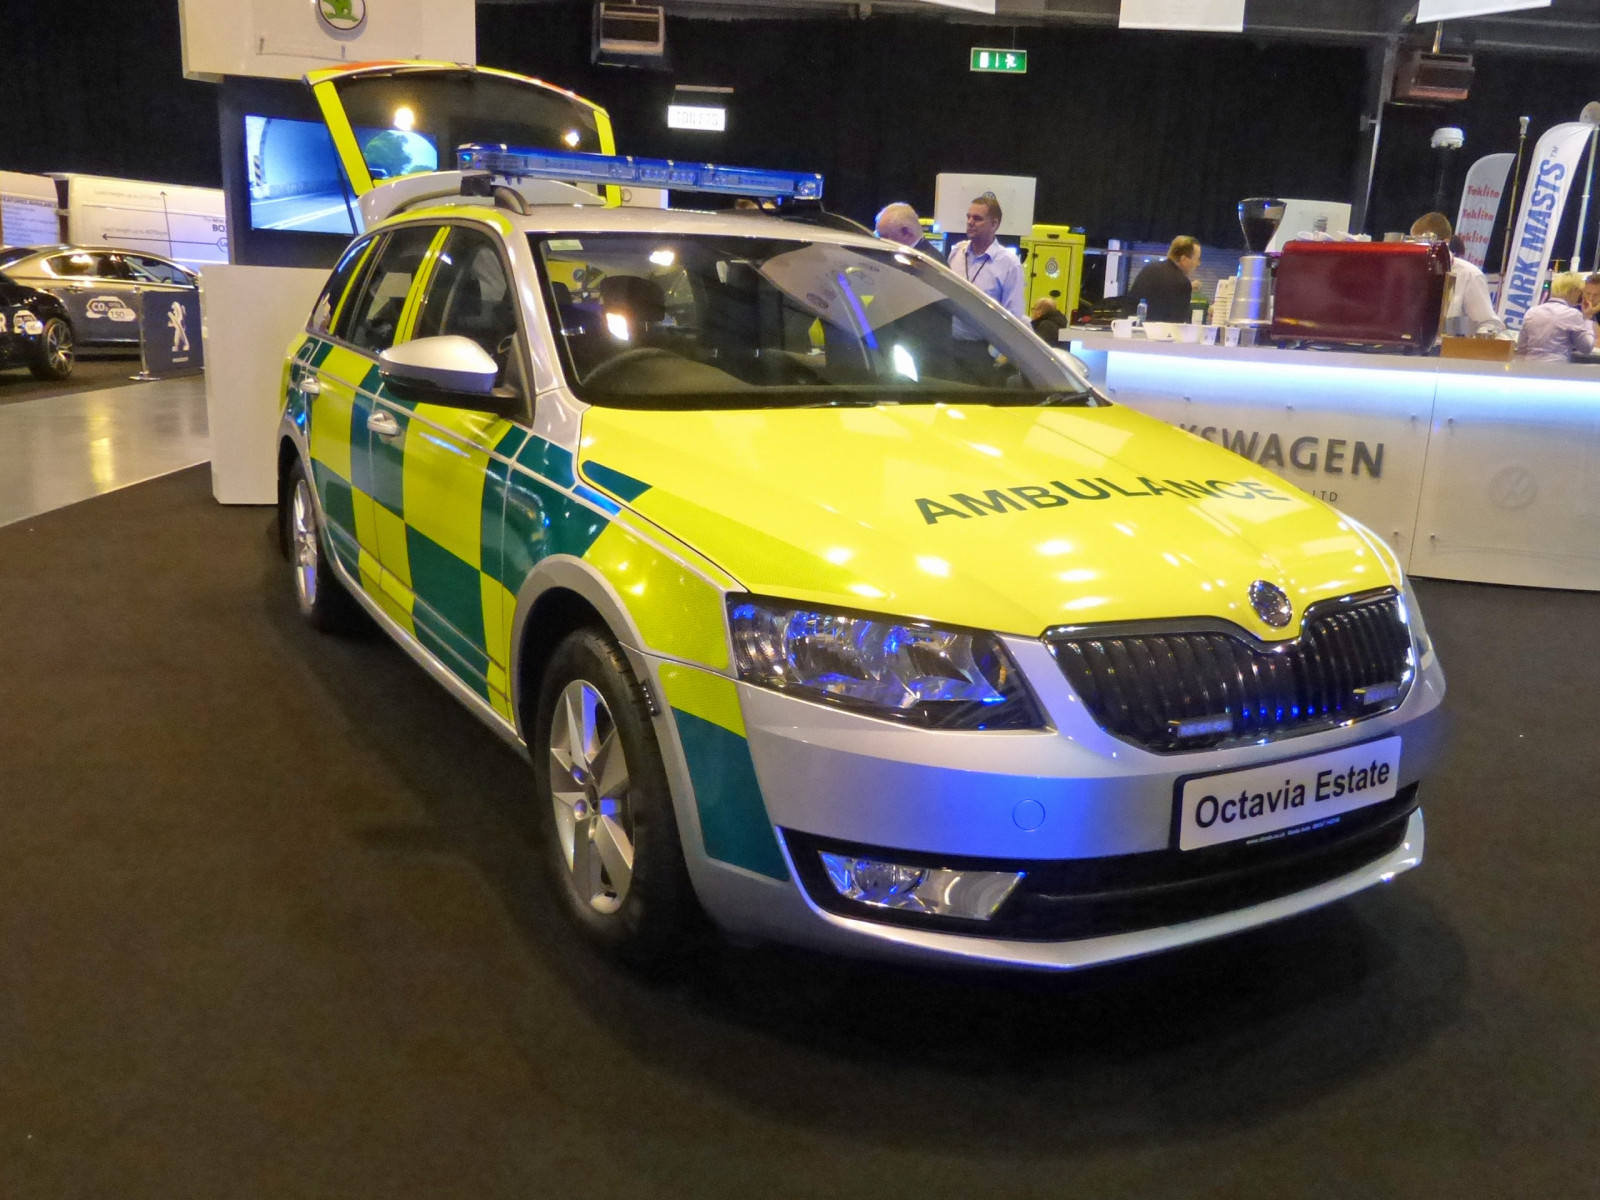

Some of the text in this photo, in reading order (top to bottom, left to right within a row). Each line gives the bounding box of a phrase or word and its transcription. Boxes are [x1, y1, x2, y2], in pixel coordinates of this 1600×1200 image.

[1521, 159, 1565, 253] MASTS
[1503, 255, 1540, 331] CLARK
[914, 477, 1292, 525] AMBULANCE
[1195, 760, 1390, 829] Octavia Estate
